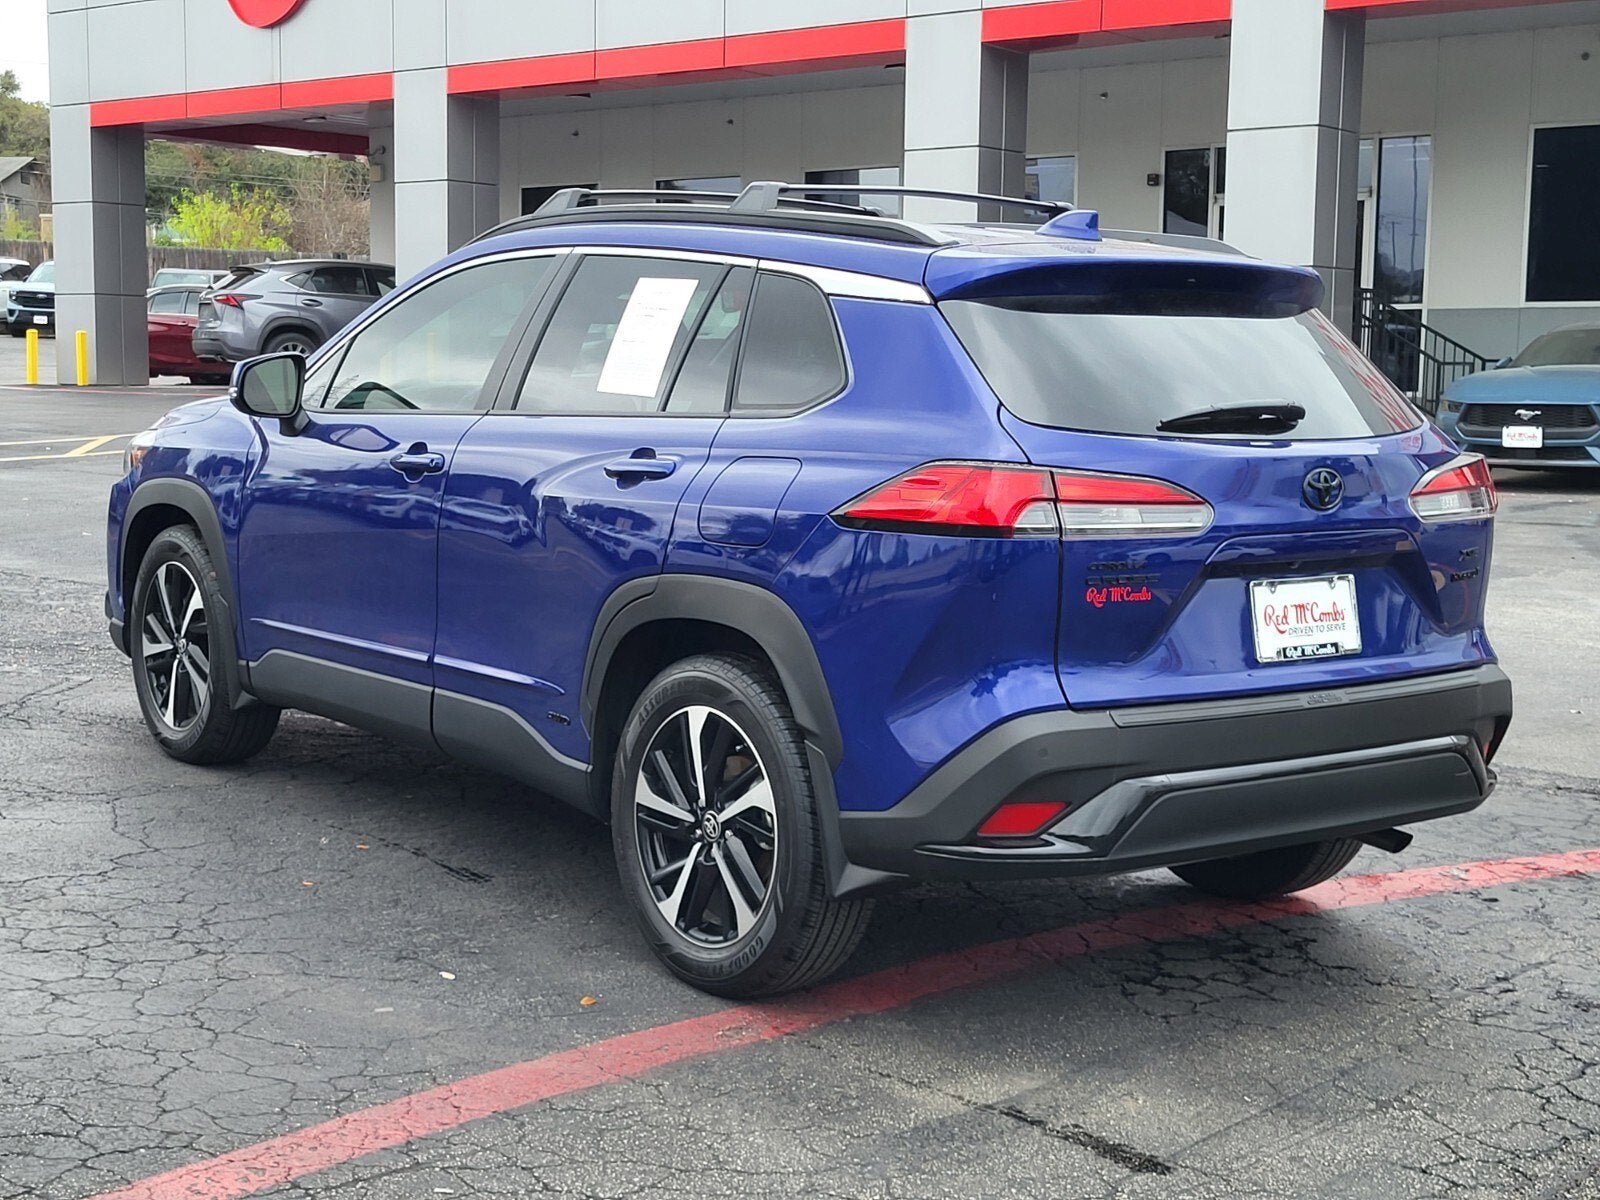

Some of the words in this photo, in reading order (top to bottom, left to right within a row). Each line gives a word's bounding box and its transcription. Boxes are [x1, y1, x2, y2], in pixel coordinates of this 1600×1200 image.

[1086, 587, 1108, 608] Red
[1109, 586, 1152, 602] McCombs
[1264, 604, 1289, 634] Red
[1290, 601, 1346, 625] McCombs
[1288, 625, 1314, 636] DRIVEN
[1315, 624, 1325, 633] TO
[1326, 622, 1346, 632] SERVE
[1286, 646, 1302, 659] Red
[698, 936, 764, 977] GOODYEA
